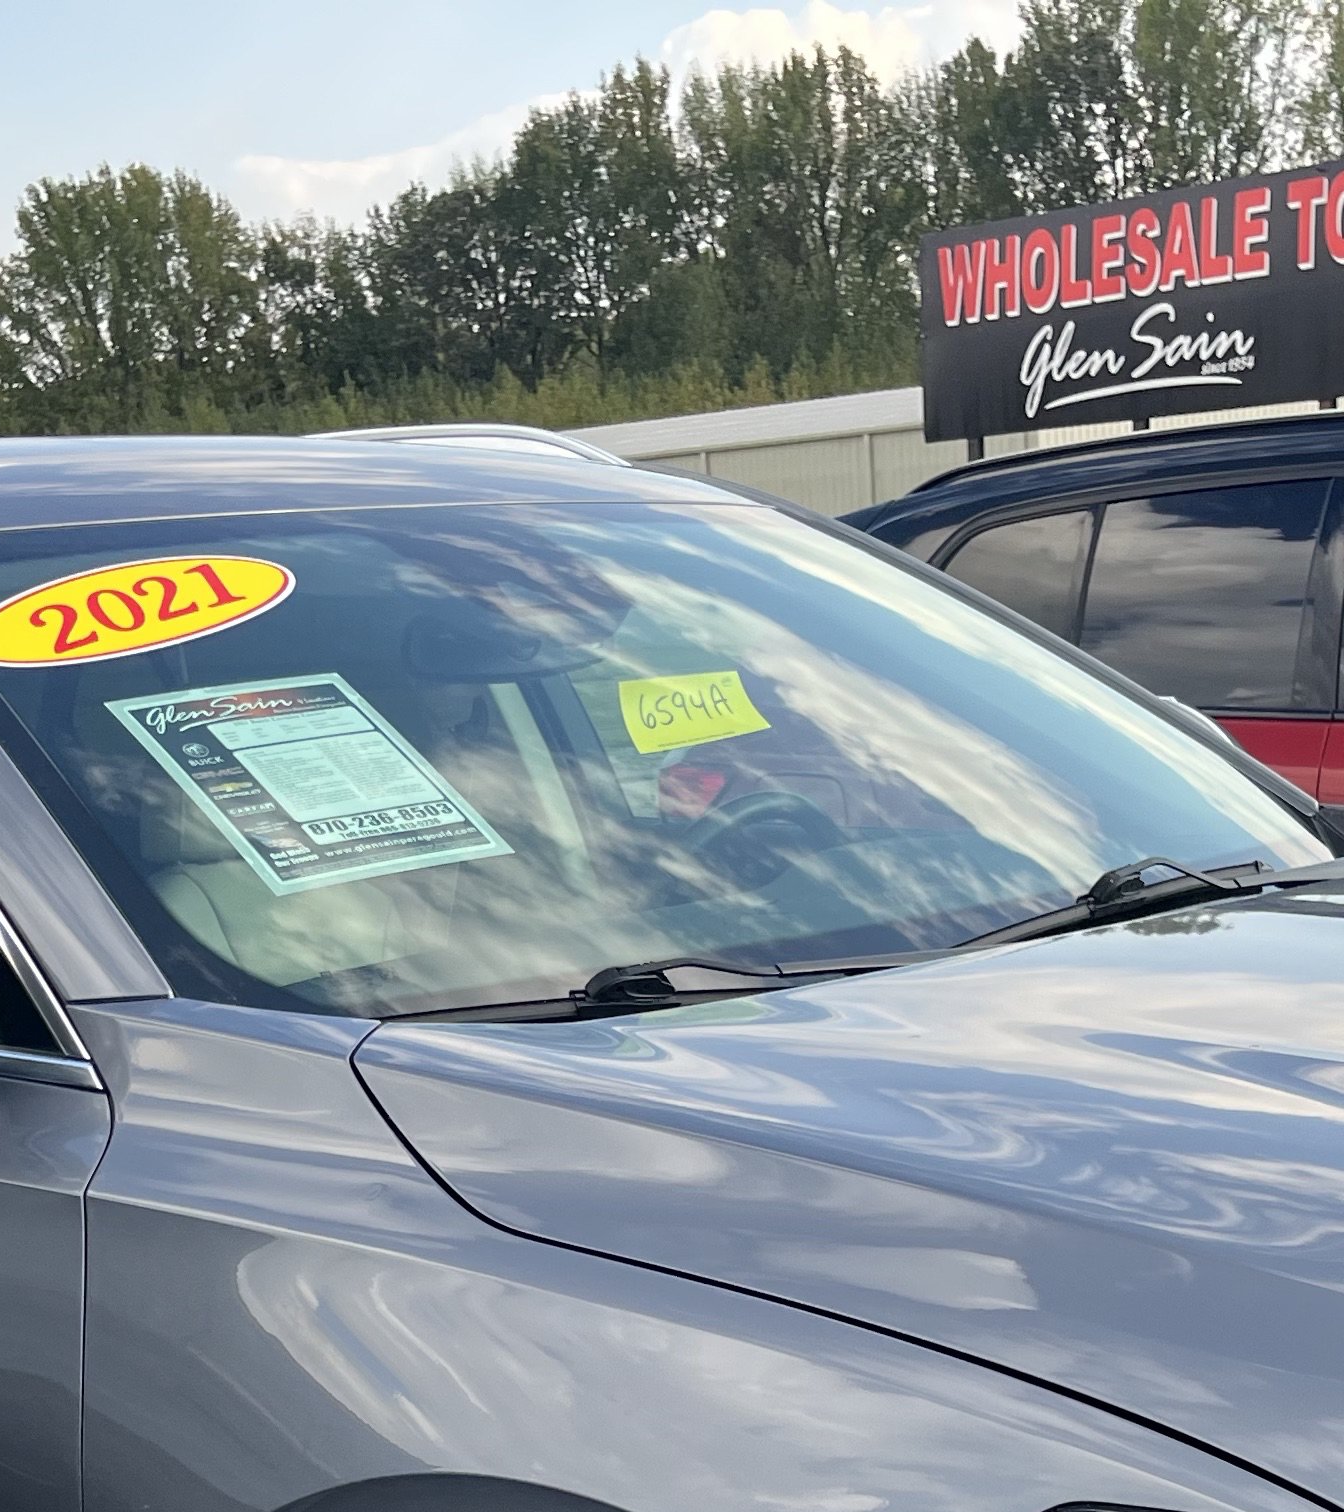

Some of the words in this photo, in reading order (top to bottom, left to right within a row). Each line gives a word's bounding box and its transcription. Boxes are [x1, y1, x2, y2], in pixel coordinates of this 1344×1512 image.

[937, 186, 1271, 328] WHOLESALE
[1019, 320, 1126, 419] Glen
[1130, 302, 1255, 379] Sain
[29, 563, 248, 654] 2021
[145, 704, 215, 735] Glen
[210, 696, 293, 718] Sain
[639, 683, 735, 730] 6594A
[188, 755, 224, 767] BUICK
[308, 802, 454, 836] 870-236-8503
